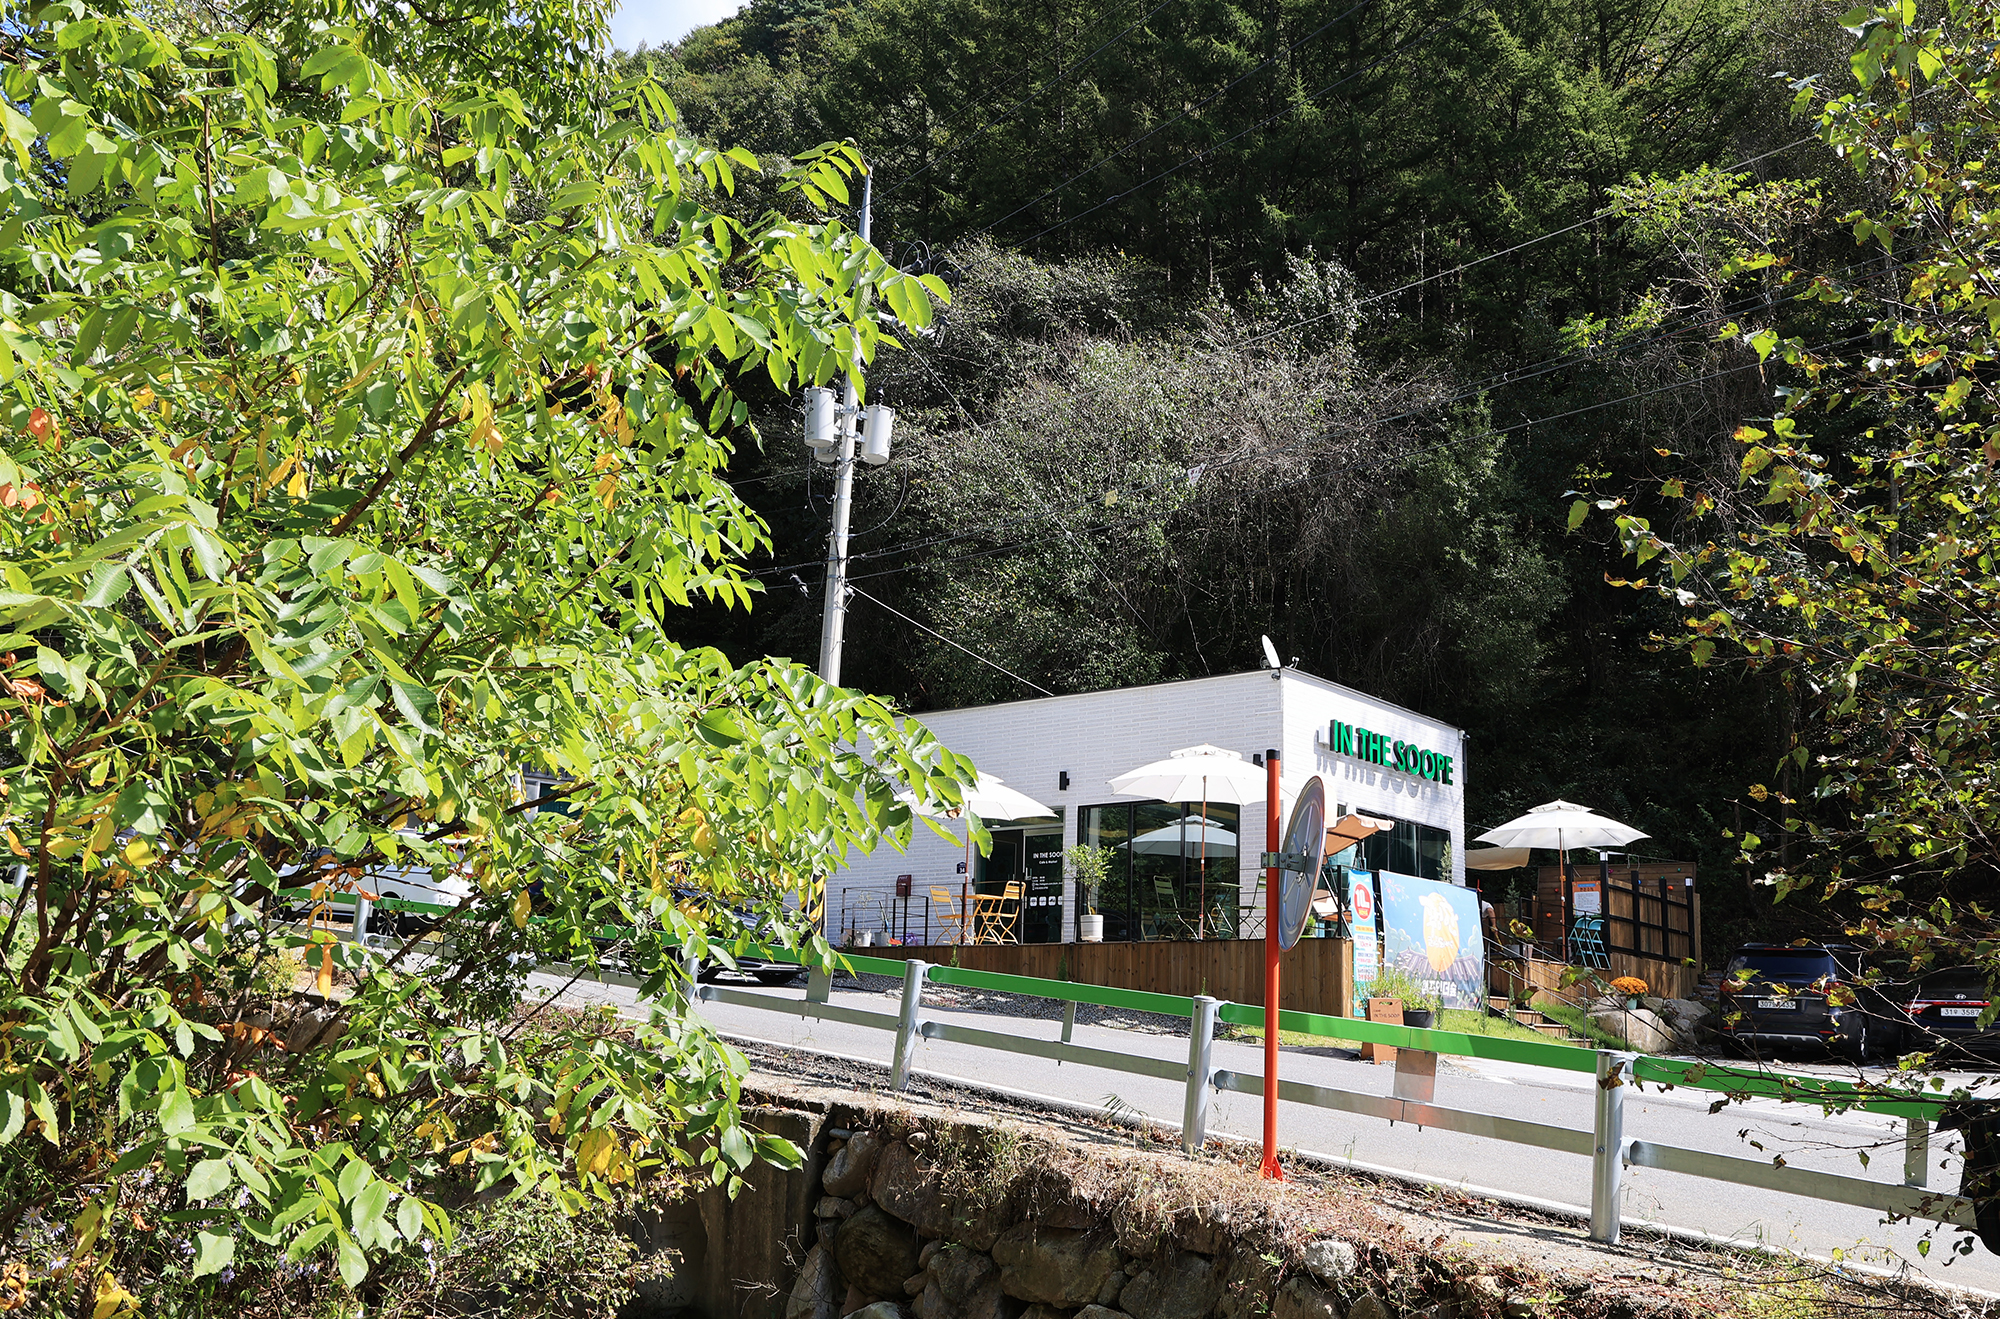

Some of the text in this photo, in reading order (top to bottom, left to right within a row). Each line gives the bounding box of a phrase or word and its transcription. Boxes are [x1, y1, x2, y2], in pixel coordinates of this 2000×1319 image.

[1330, 719, 1453, 785] IN THE SOOPE
[1961, 1008, 1980, 1016] 3587
